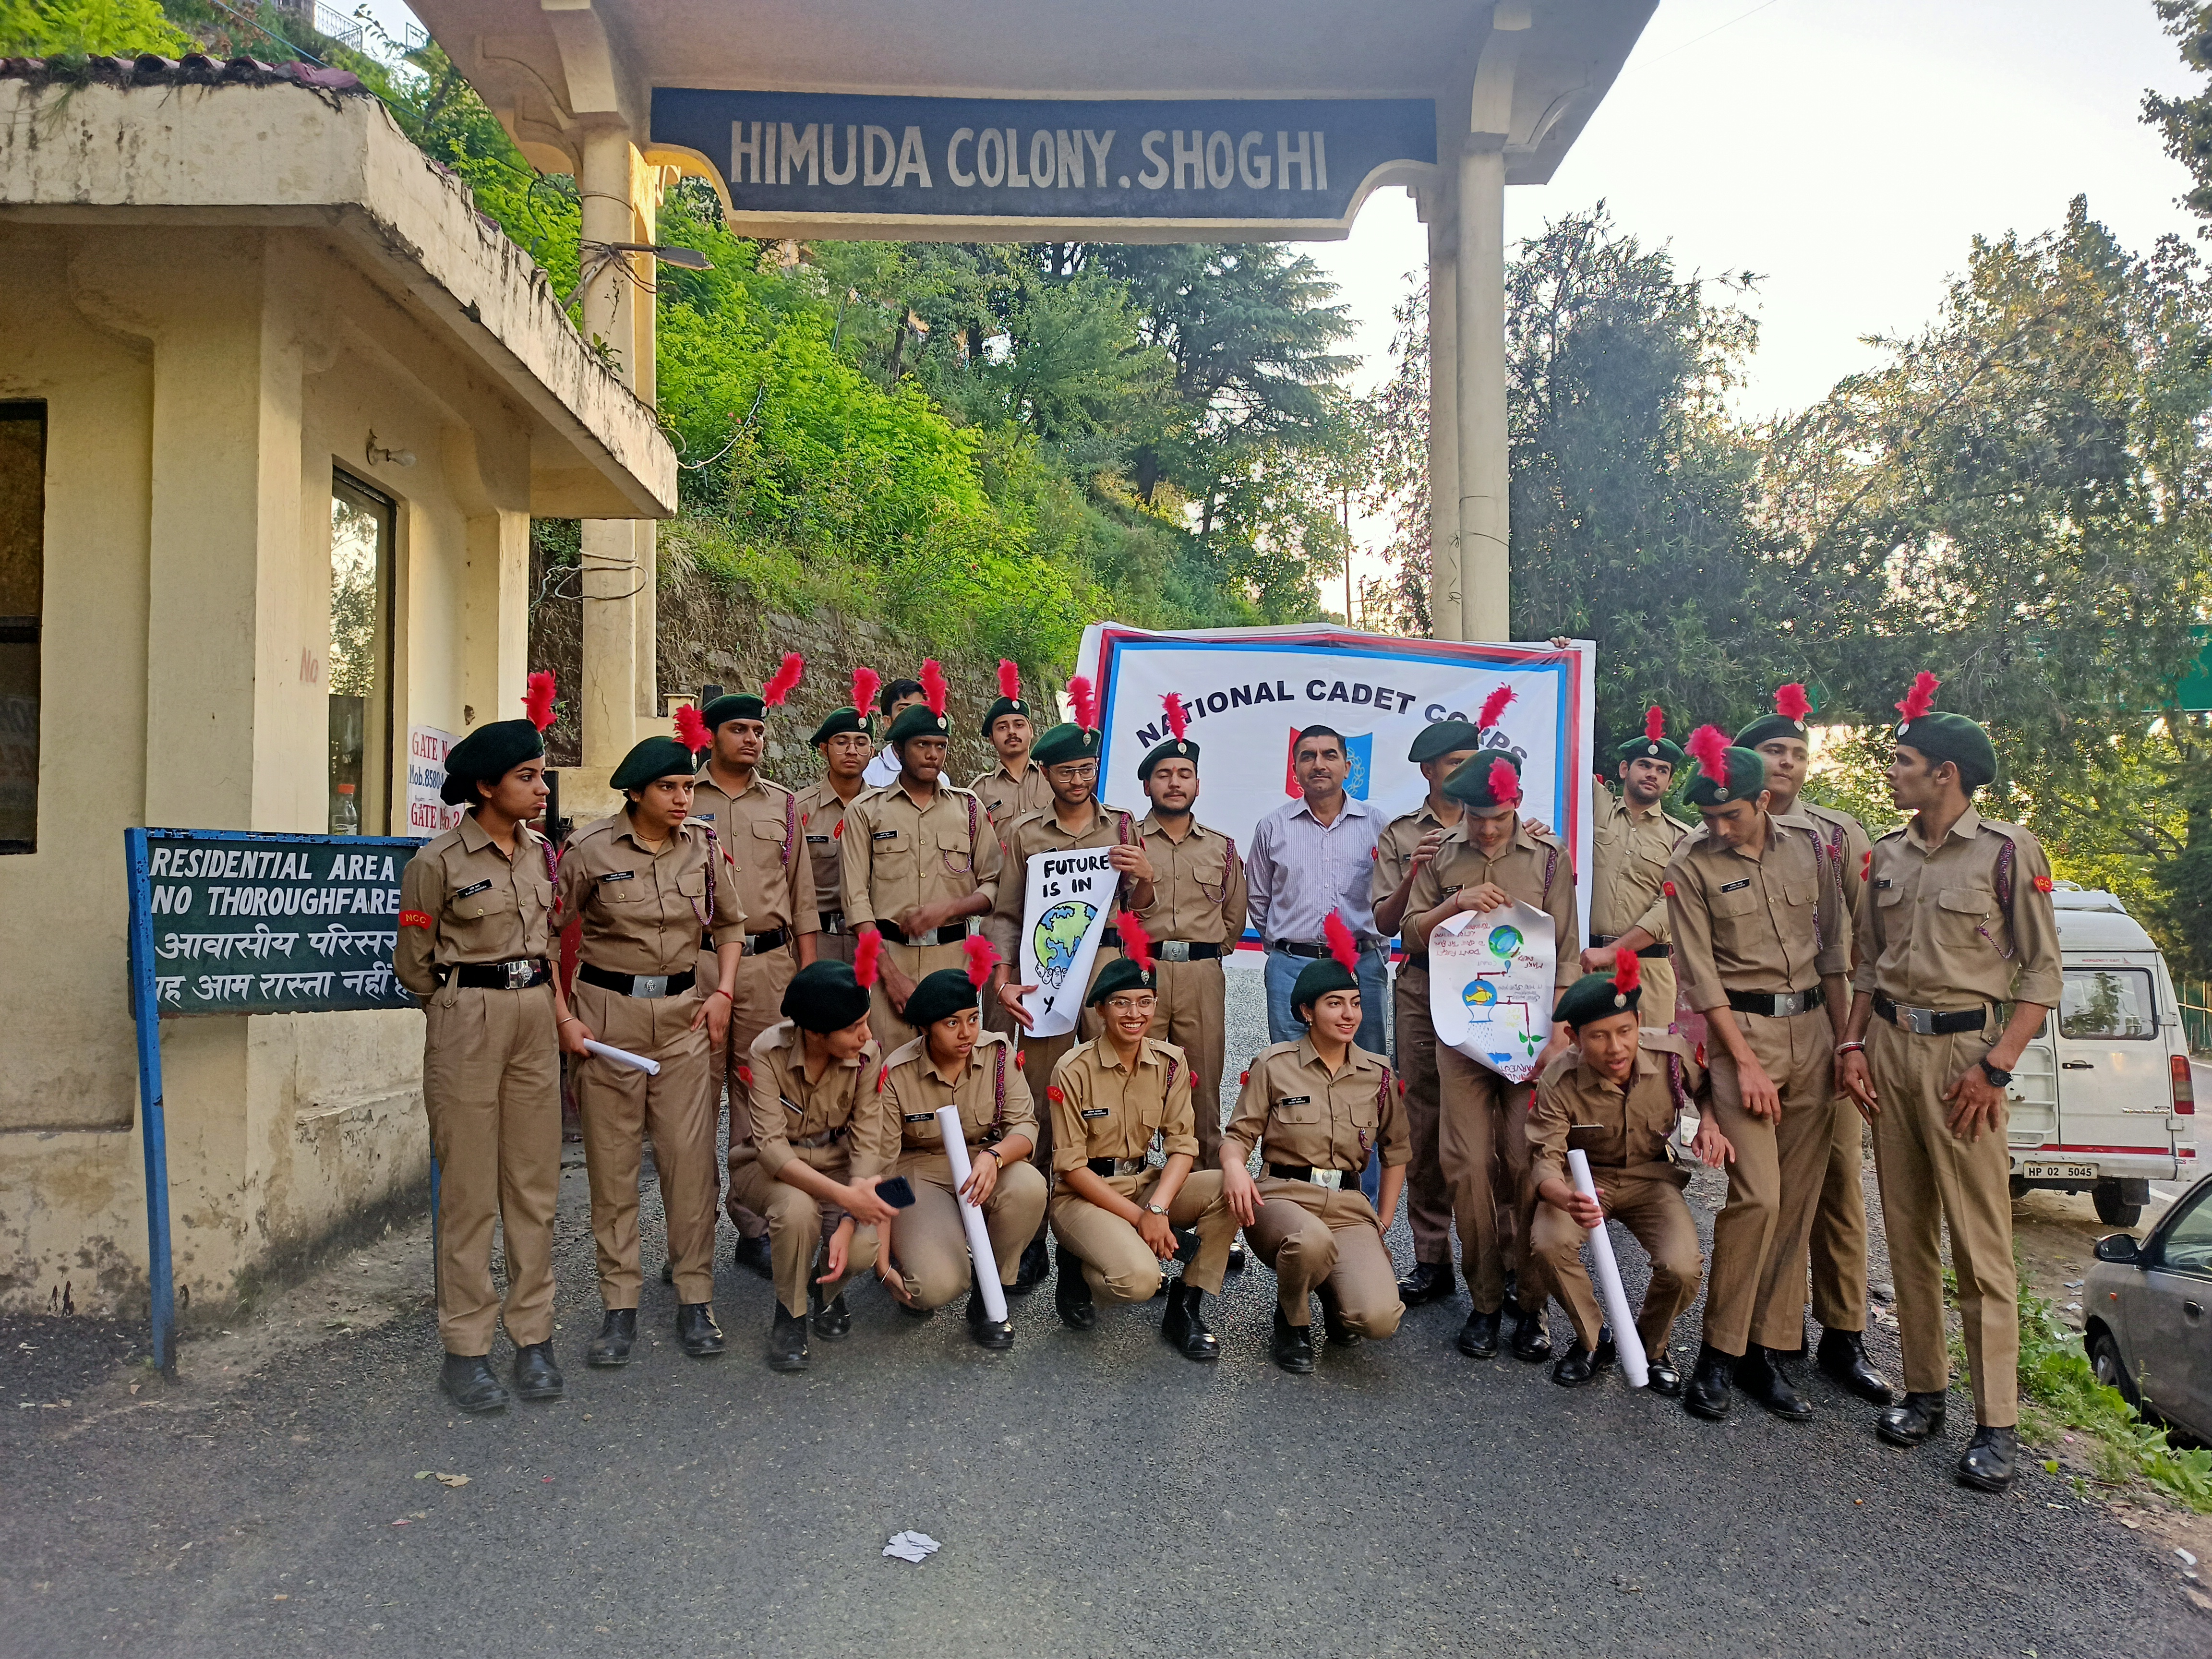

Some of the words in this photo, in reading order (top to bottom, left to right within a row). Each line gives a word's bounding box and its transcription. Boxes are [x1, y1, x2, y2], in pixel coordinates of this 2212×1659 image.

[731, 120, 933, 188] HIMUDA
[1138, 130, 1327, 191] SHOGHI
[1306, 679, 1416, 715] CADET
[1425, 704, 1527, 765] CPS
[412, 732, 437, 761] GATE
[411, 803, 436, 829] GATE
[150, 848, 313, 879] RESIDENTIAL
[327, 854, 395, 882] AREA
[1044, 854, 1109, 878] FUTURE
[1043, 881, 1061, 898] IS
[1071, 877, 1092, 893] IN
[2036, 878, 2050, 888] NCC
[151, 885, 192, 914] NO
[208, 886, 401, 916] THOROUGHFARE
[405, 914, 426, 924] NCC
[155, 923, 300, 960] आवासीय
[307, 923, 397, 958] परिसर
[192, 974, 255, 1002] आम
[260, 972, 336, 1000] रास्ता
[341, 961, 394, 1000] नहीं
[2028, 1167, 2042, 1176] HP
[2047, 1167, 2059, 1176] 02
[2068, 1168, 2092, 1176] 5045
